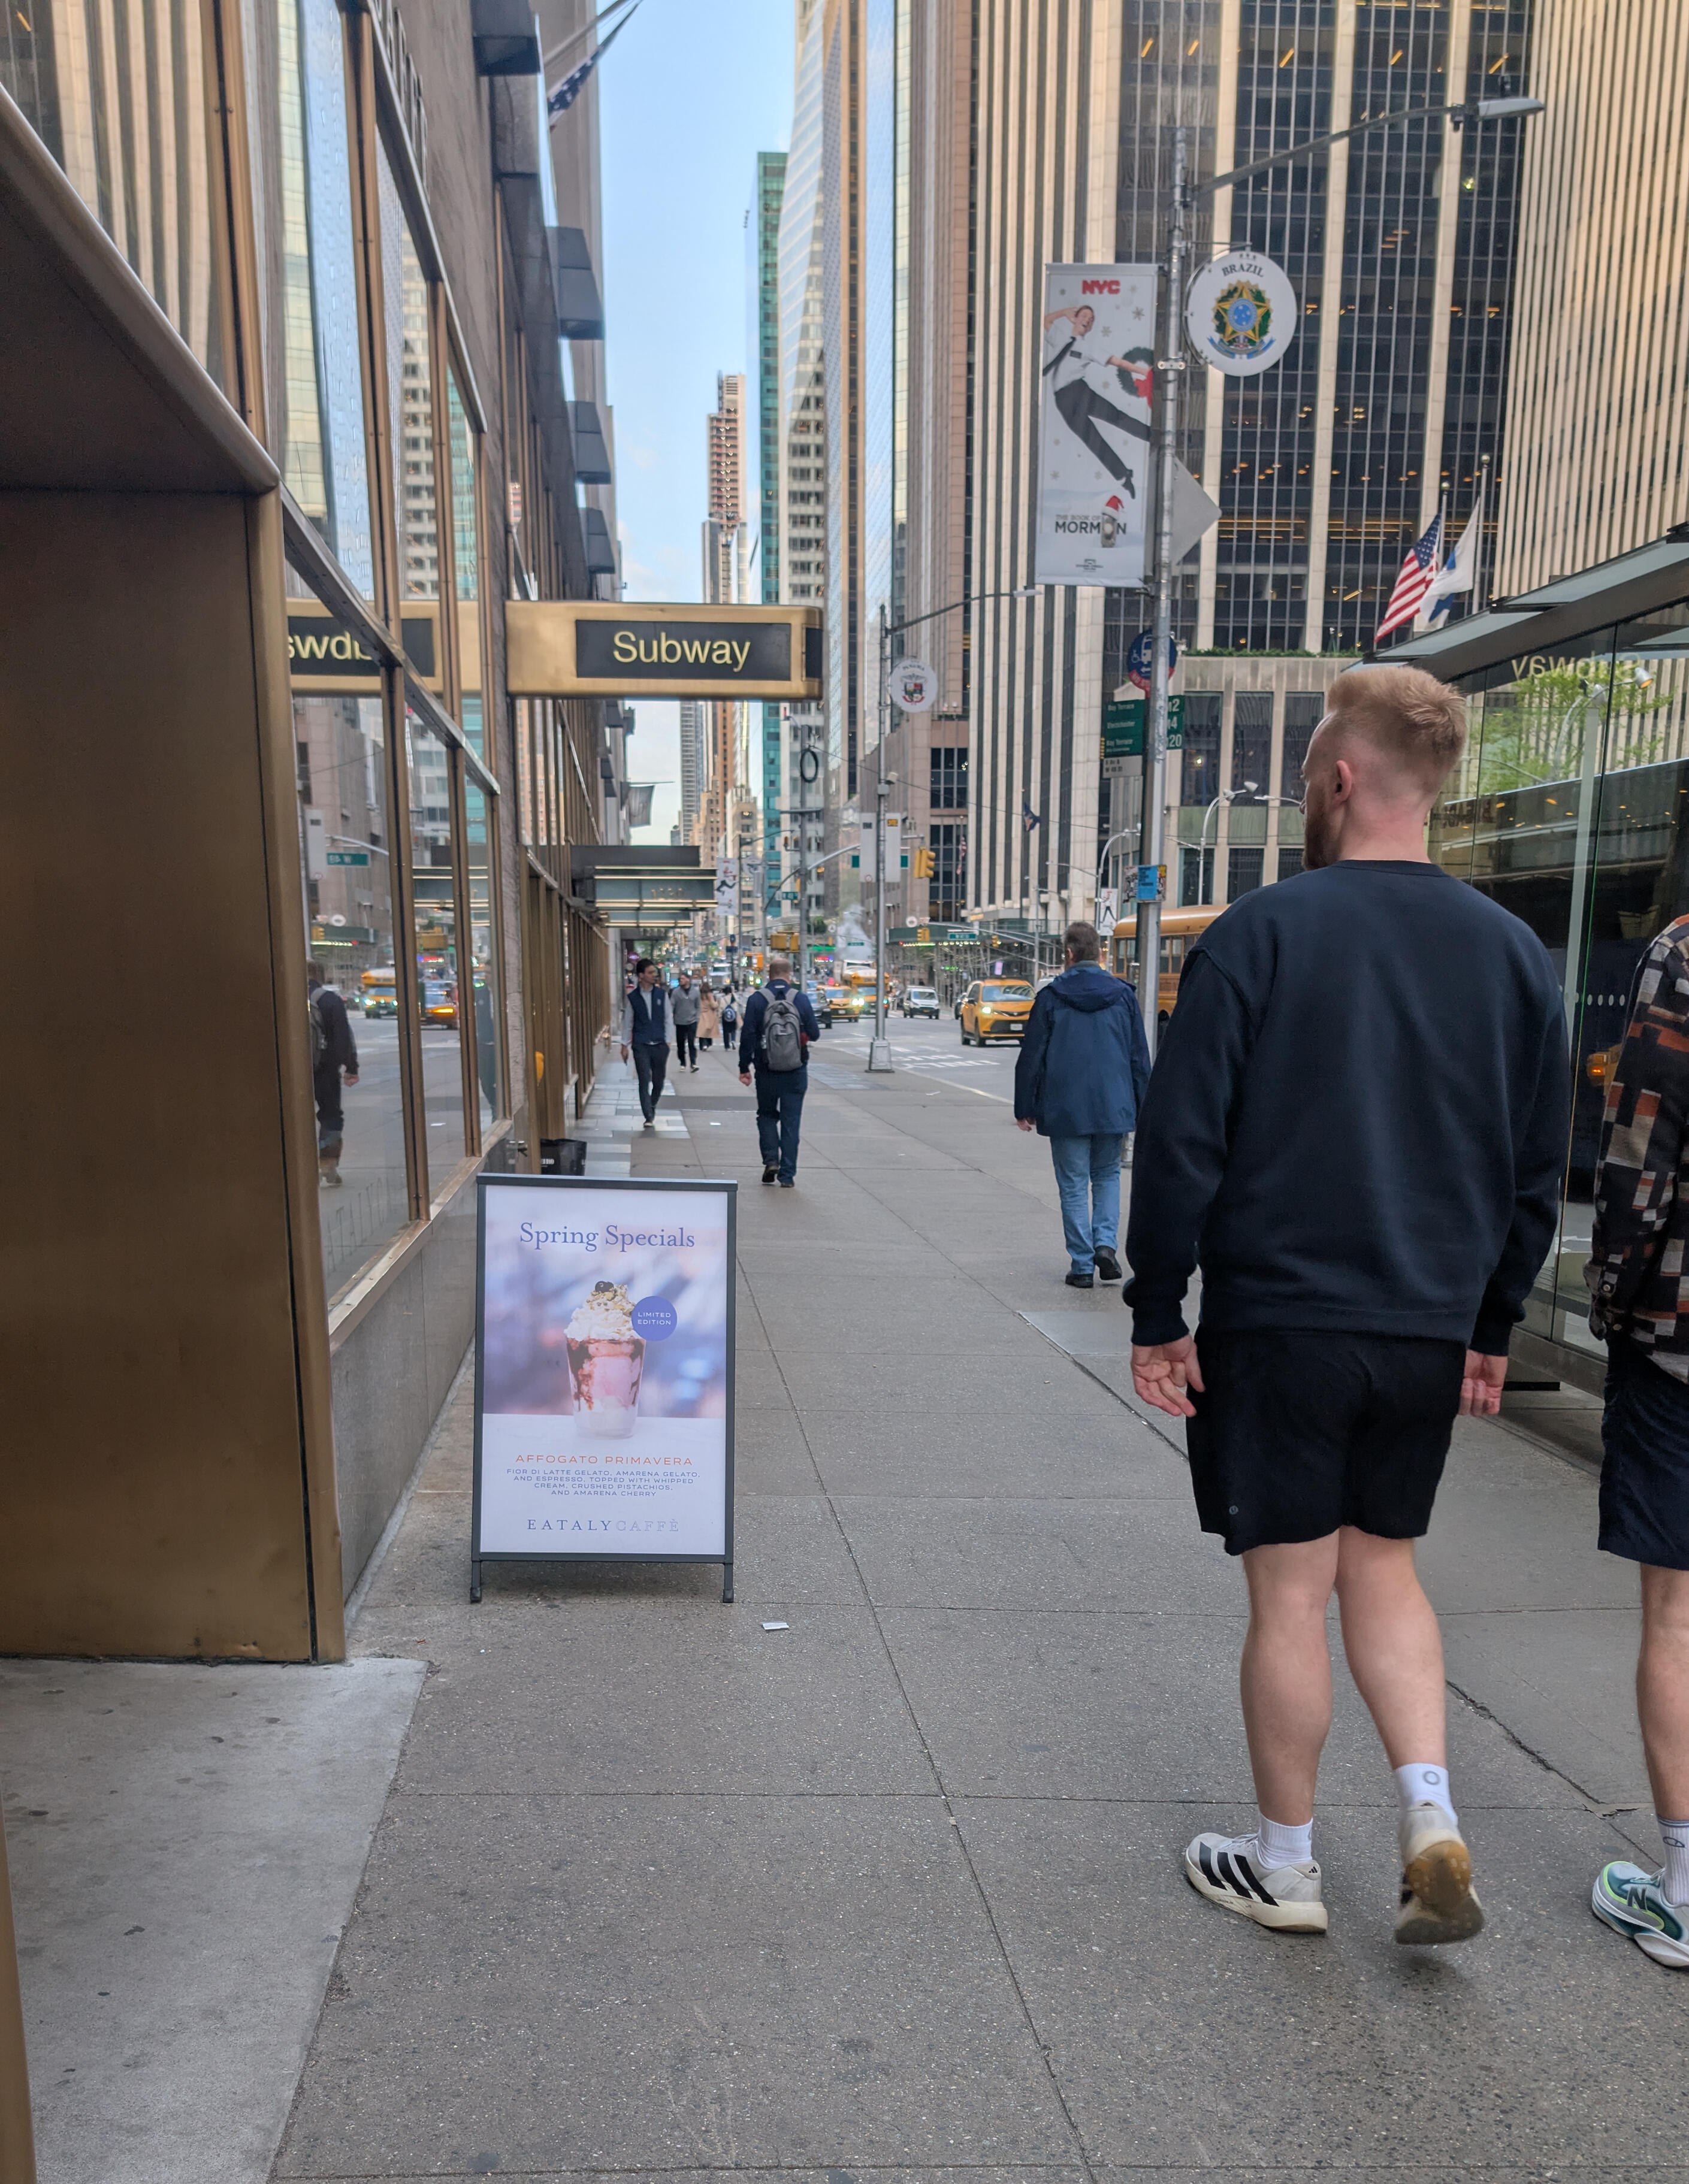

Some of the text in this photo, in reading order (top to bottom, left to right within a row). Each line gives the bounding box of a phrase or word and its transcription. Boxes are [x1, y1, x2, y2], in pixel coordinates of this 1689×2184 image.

[1222, 264, 1264, 277] BRAZIL
[1082, 280, 1120, 295] NYC
[613, 631, 751, 672] Subway
[520, 1222, 695, 1253] Spring Specials
[515, 1454, 693, 1466] AFFOGATO PRIMAVERA
[527, 1519, 612, 1531] EATALY
